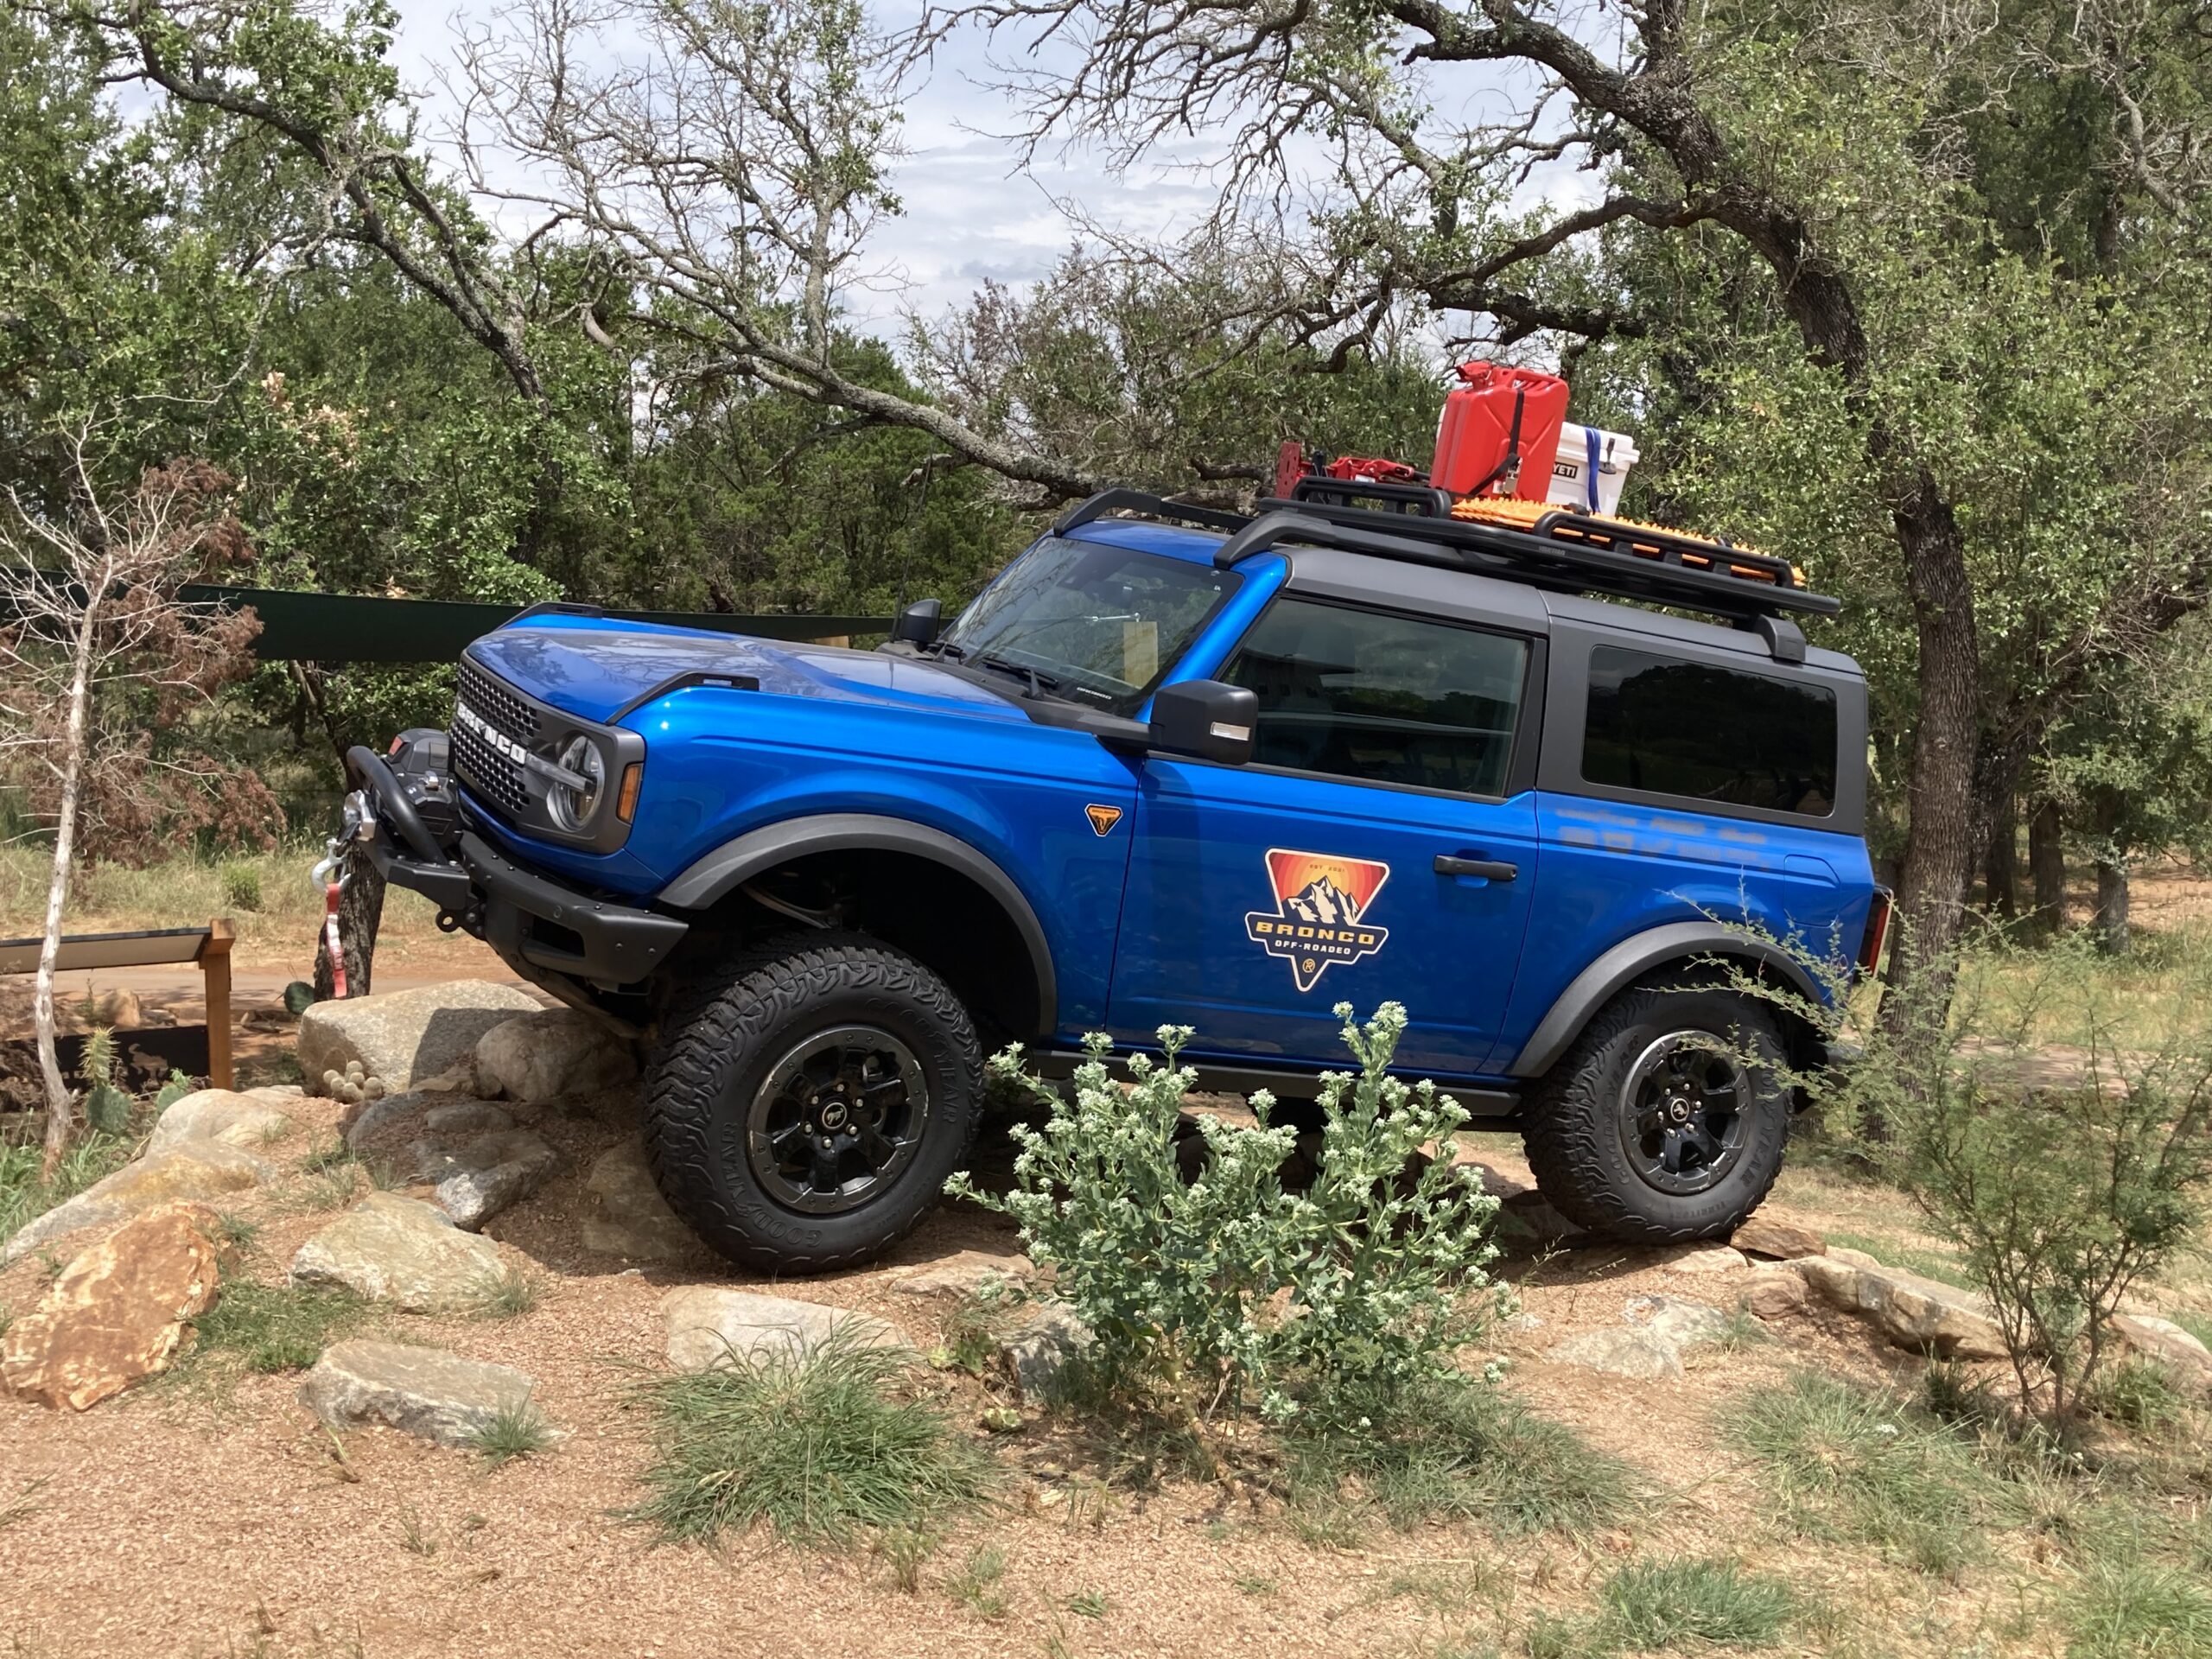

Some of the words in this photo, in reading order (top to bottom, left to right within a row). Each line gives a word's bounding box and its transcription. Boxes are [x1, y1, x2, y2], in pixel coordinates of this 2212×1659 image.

[1553, 463, 1577, 477] YETI
[1255, 920, 1376, 945] BRONCO
[1274, 939, 1351, 955] OFF-ROADEO
[721, 1122, 823, 1248] GOODYEAR
